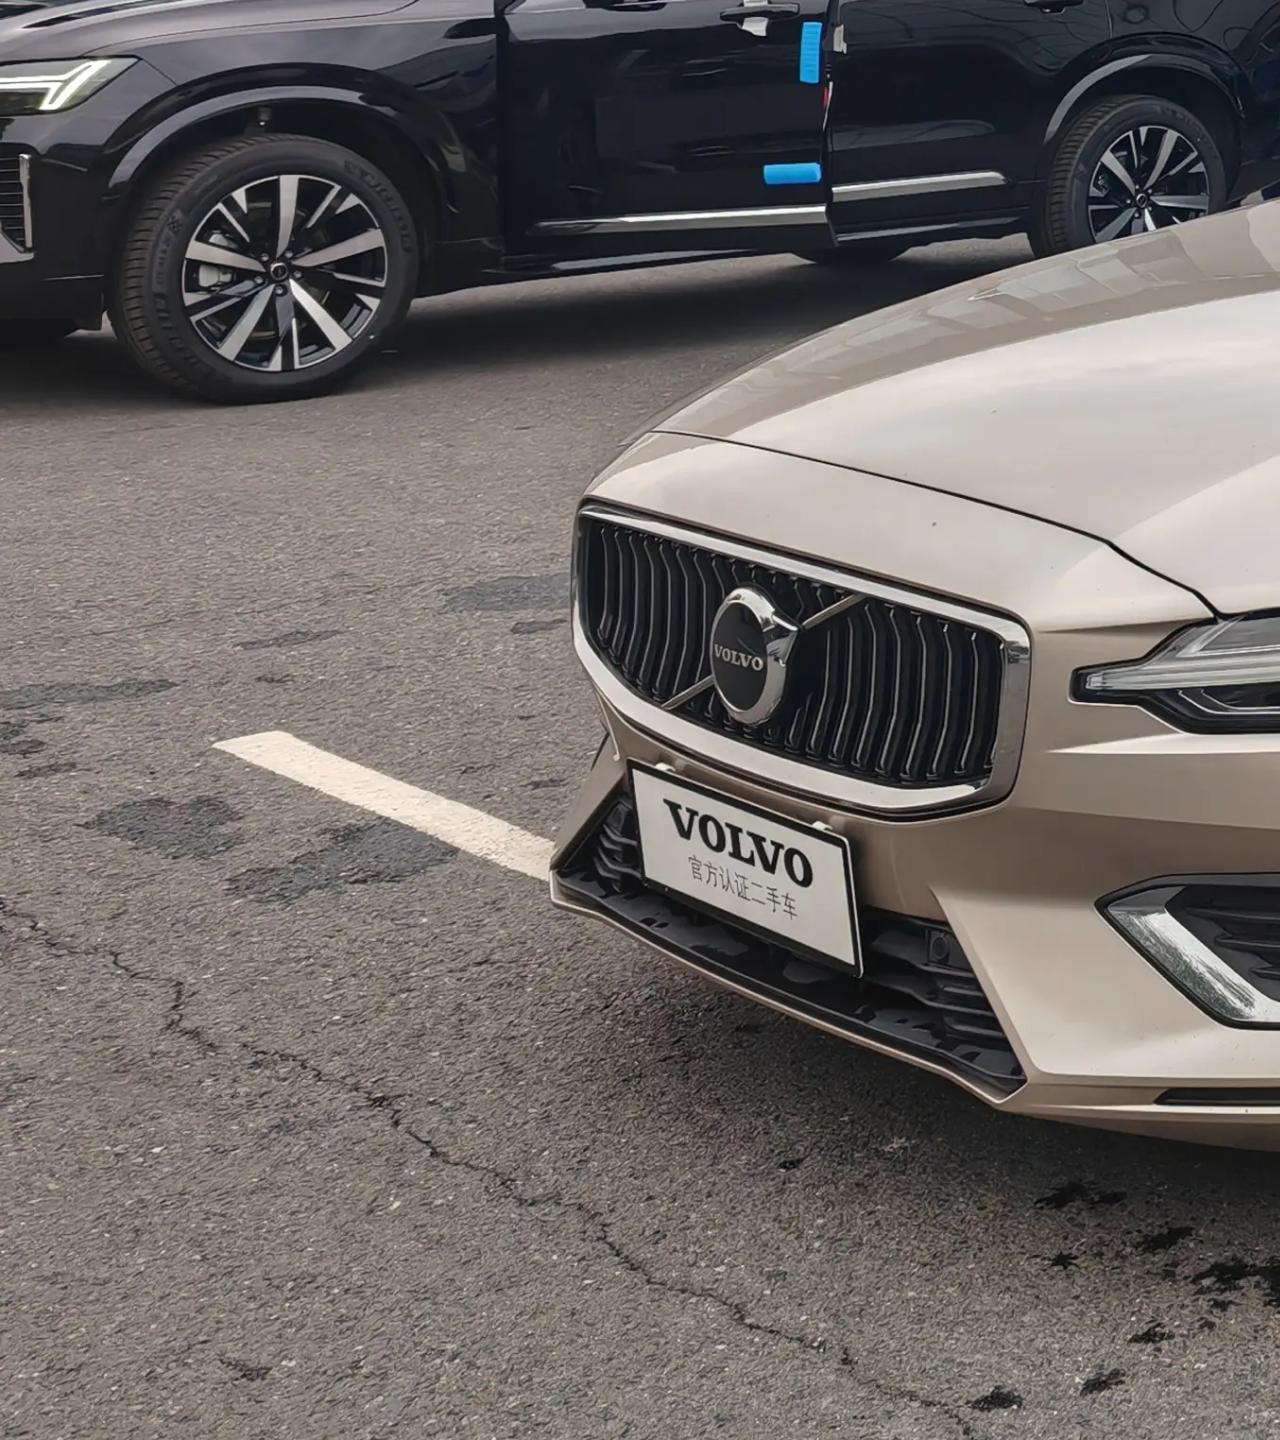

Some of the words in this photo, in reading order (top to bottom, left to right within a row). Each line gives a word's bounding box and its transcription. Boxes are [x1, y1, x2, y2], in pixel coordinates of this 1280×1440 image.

[714, 644, 764, 671] VOLVO
[663, 798, 813, 888] VOLVO
[688, 855, 798, 920] 官方认证二手车
